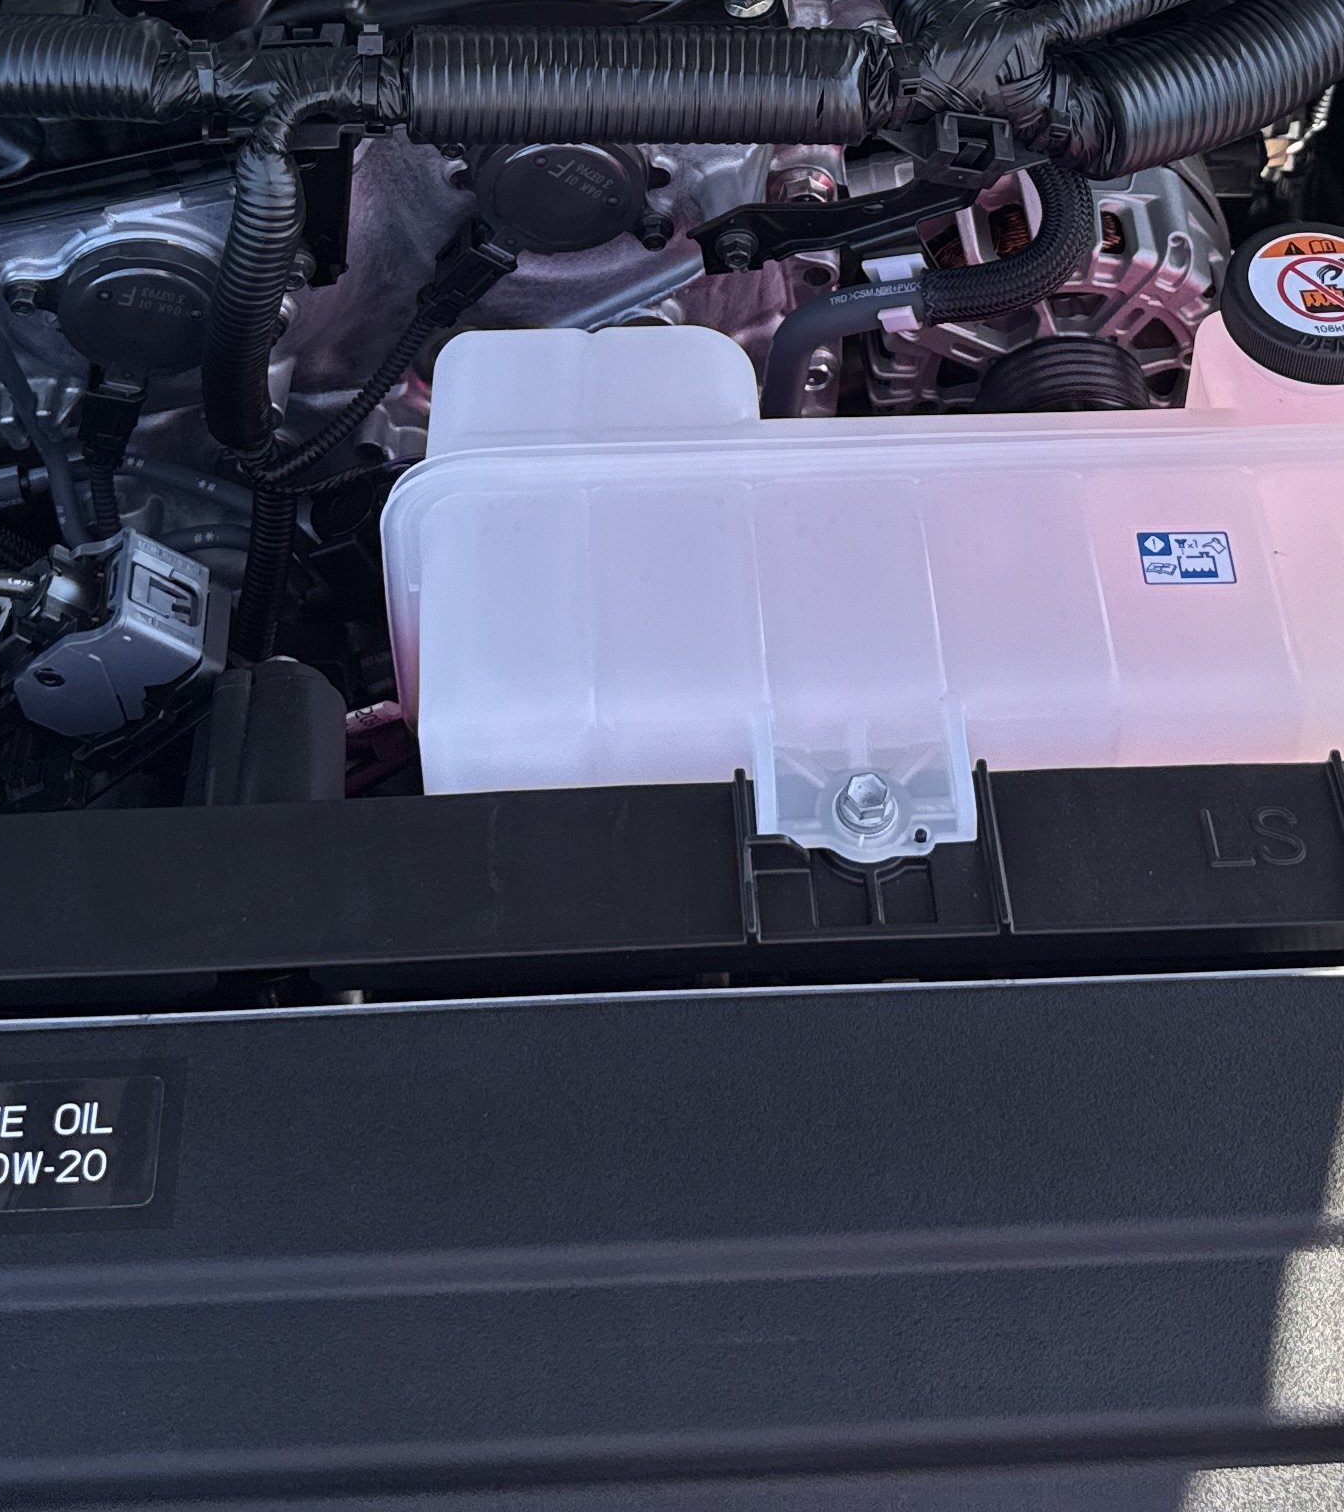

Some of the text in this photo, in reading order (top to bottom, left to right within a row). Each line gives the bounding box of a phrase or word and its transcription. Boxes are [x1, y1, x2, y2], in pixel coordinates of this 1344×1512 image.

[547, 159, 575, 179] F
[118, 286, 137, 307] F
[829, 293, 848, 306] TRD
[1198, 804, 1307, 869] LS
[54, 1102, 113, 1136] OIL
